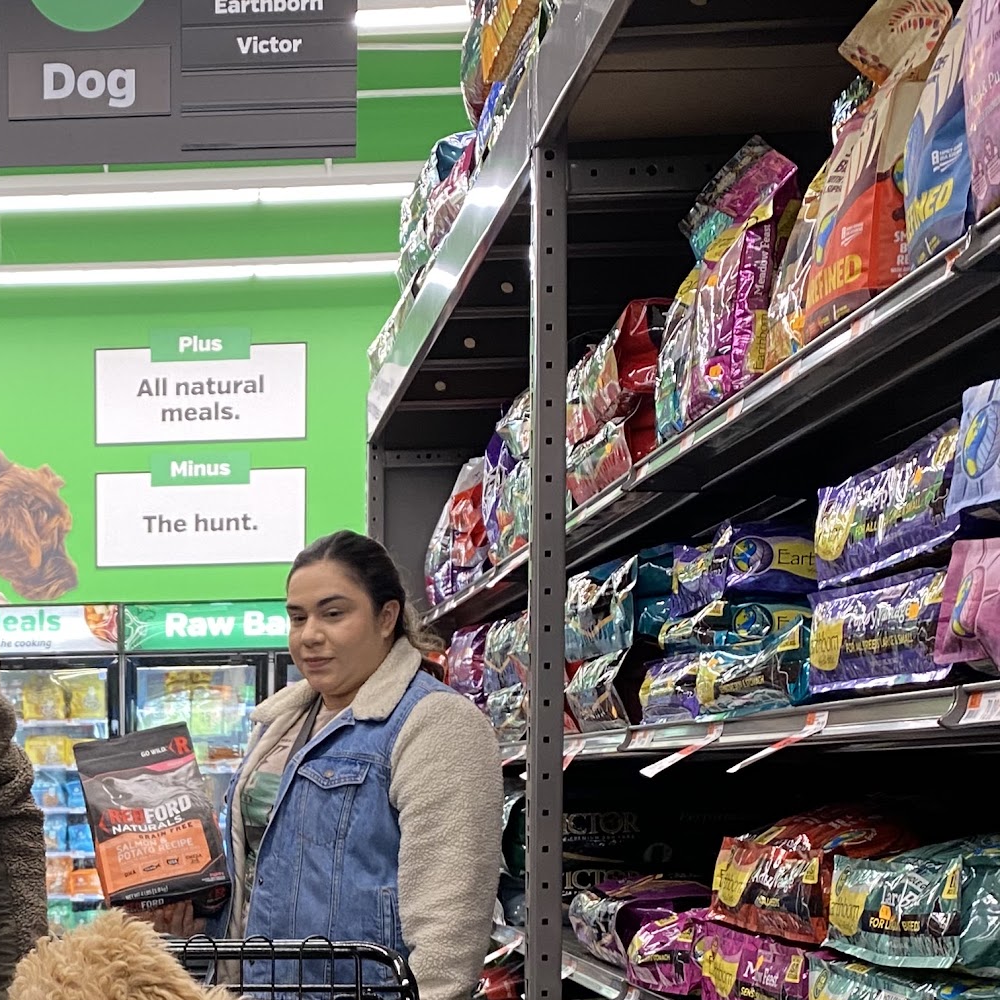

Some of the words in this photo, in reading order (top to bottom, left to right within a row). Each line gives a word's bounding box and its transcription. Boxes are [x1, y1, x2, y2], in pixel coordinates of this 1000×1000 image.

[215, 0, 323, 15] Earthborn
[237, 36, 302, 55] Victor
[43, 62, 136, 107] Dog
[757, 223, 772, 247] Feast
[754, 249, 771, 297] Meadow
[179, 336, 222, 352] Plus
[754, 312, 768, 370] Earthborn
[136, 378, 167, 397] All
[175, 374, 265, 396] natural
[161, 402, 240, 422] meals.
[170, 460, 230, 477] Minus
[142, 515, 187, 533] The
[194, 513, 258, 532] hunt.
[165, 613, 235, 638] Raw
[14, 639, 52, 650] cooking
[108, 795, 192, 824] REDFORD
[112, 815, 184, 835] NATURALS
[155, 838, 193, 853] RECIPE
